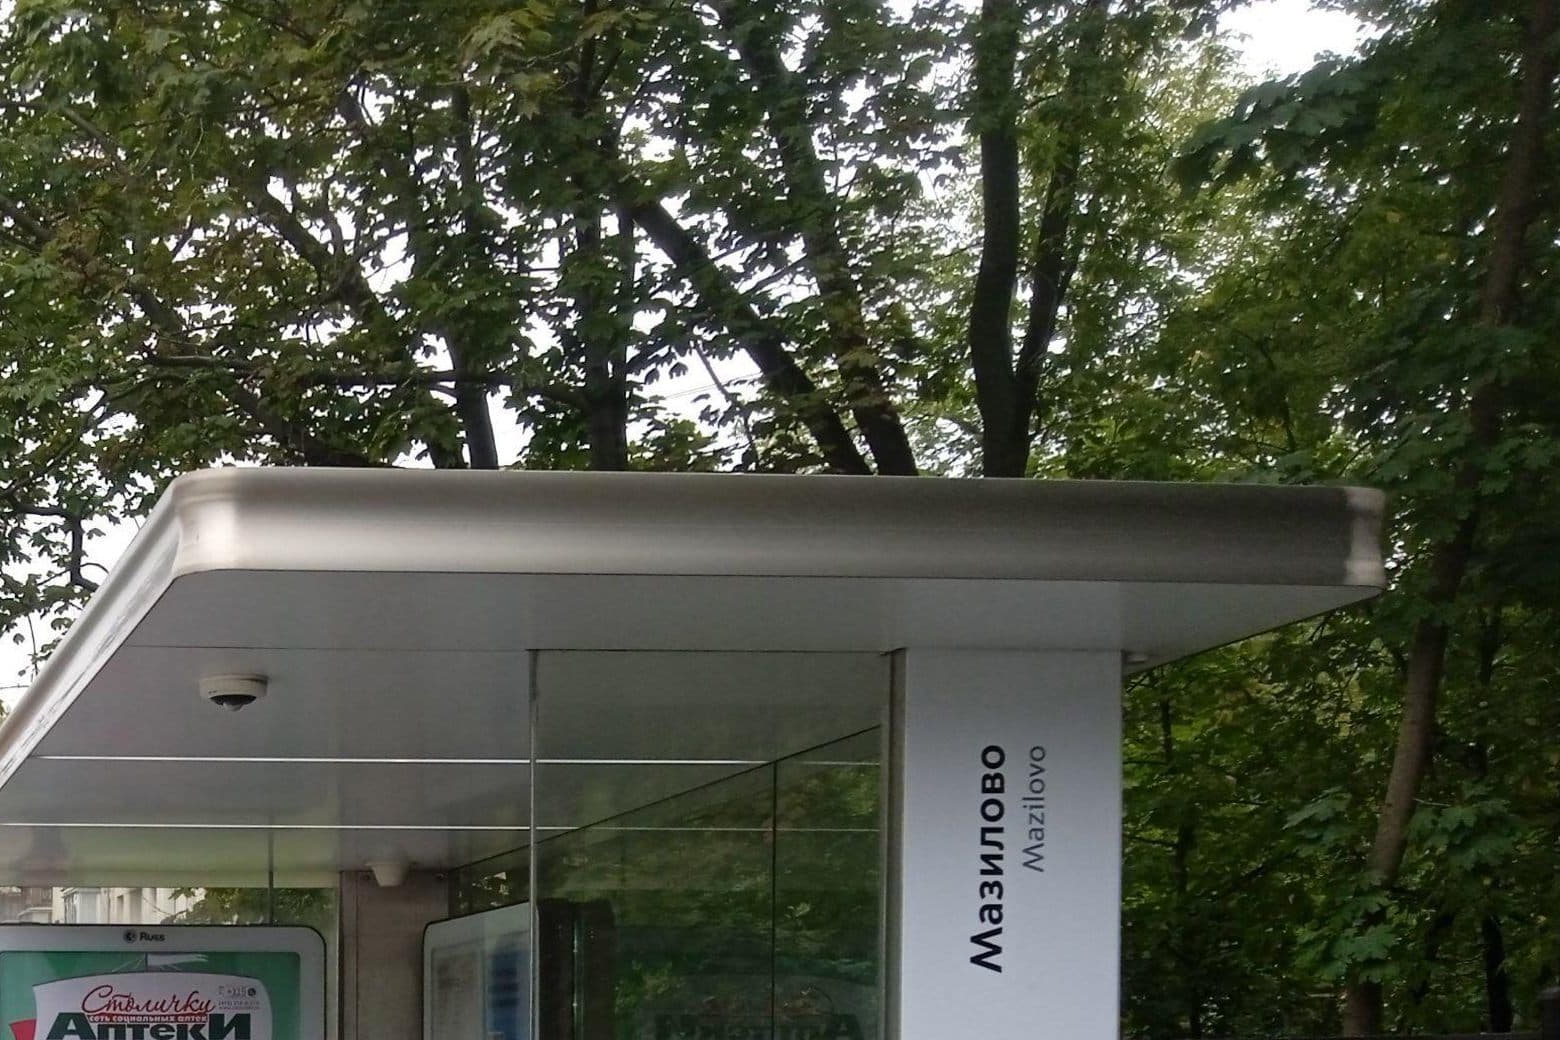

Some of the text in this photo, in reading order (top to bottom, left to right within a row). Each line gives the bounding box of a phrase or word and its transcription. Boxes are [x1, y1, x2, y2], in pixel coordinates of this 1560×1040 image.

[970, 743, 1006, 974] Мазилово
[1022, 745, 1046, 873] Mazilovo
[81, 984, 216, 1014] Столички
